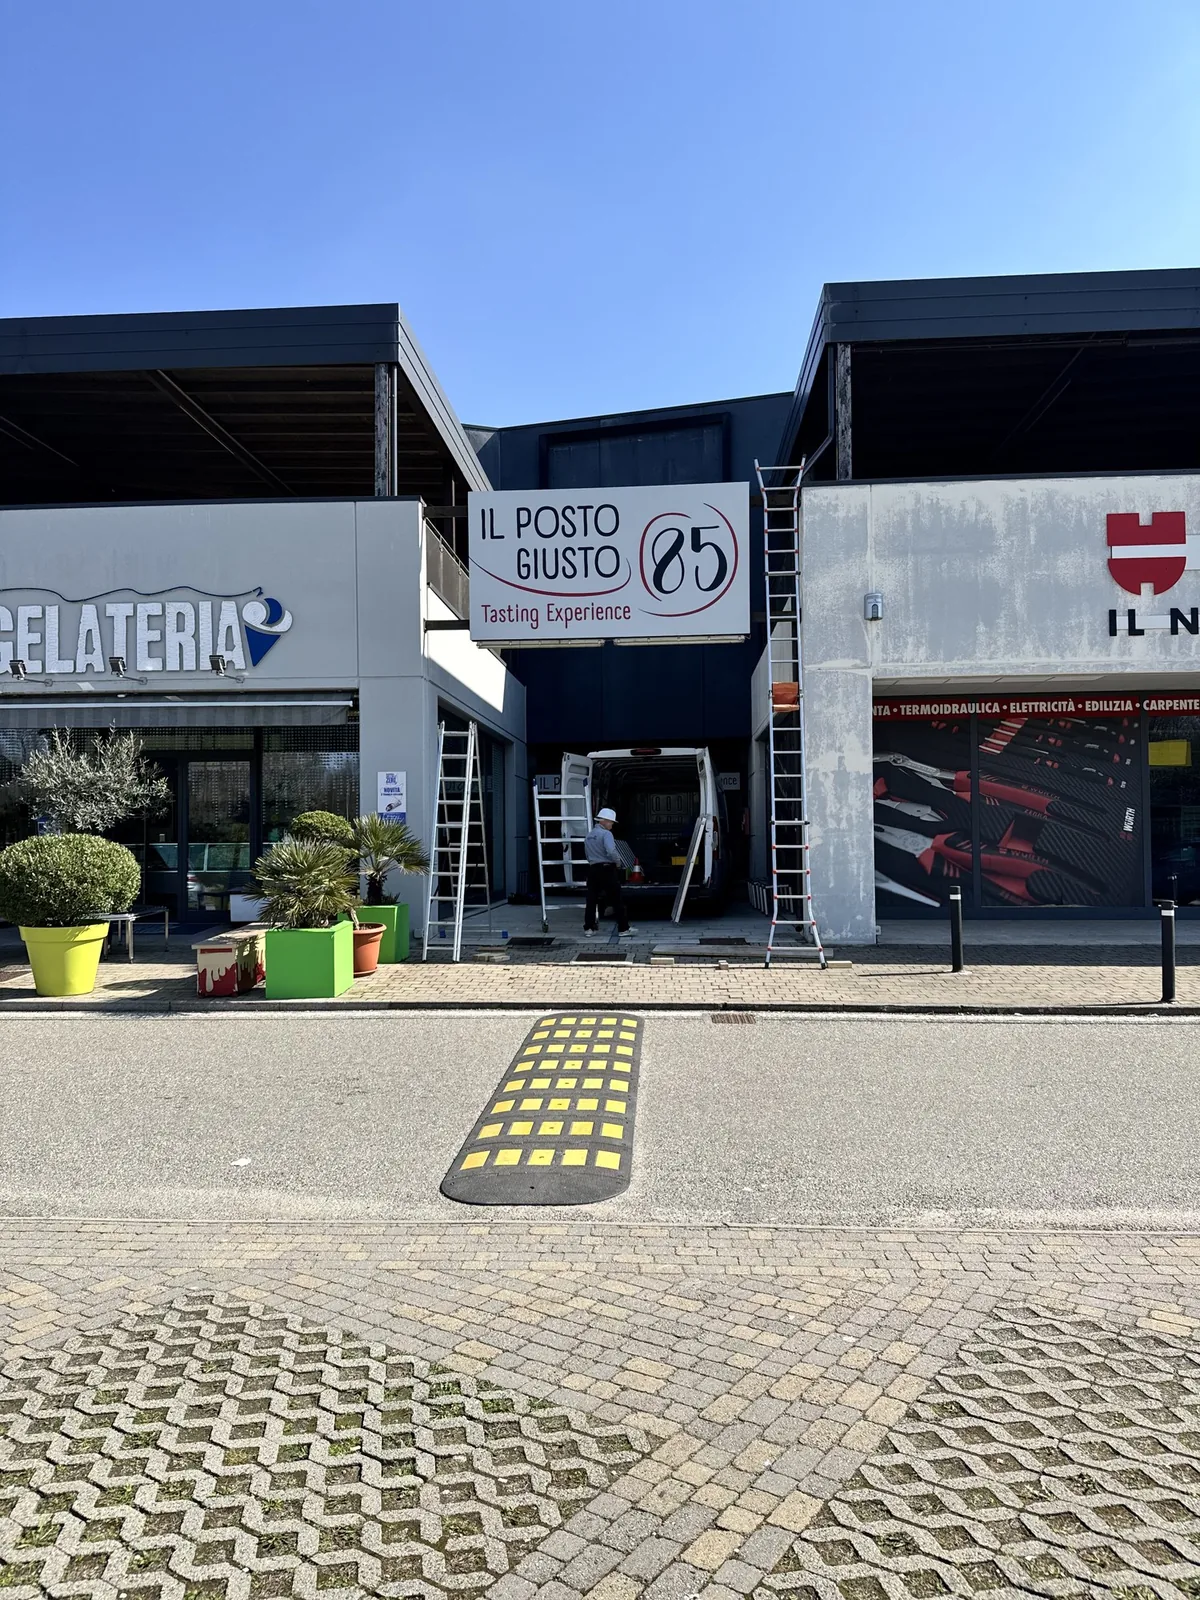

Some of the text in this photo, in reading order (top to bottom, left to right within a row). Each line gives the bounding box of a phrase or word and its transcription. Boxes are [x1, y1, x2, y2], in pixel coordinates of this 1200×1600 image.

[481, 504, 620, 540] IL POSTO
[517, 545, 621, 580] GIUSTO
[651, 526, 728, 594] 85
[481, 603, 631, 629] Tasting Experience
[1109, 607, 1199, 636] IL N
[900, 702, 1000, 715] TERMOIDRAULICA
[1010, 698, 1075, 713] ELETTRICITÀ
[1085, 700, 1133, 711] EDILIZIA
[1143, 699, 1200, 711] CARPENTE
[539, 776, 550, 790] IL
